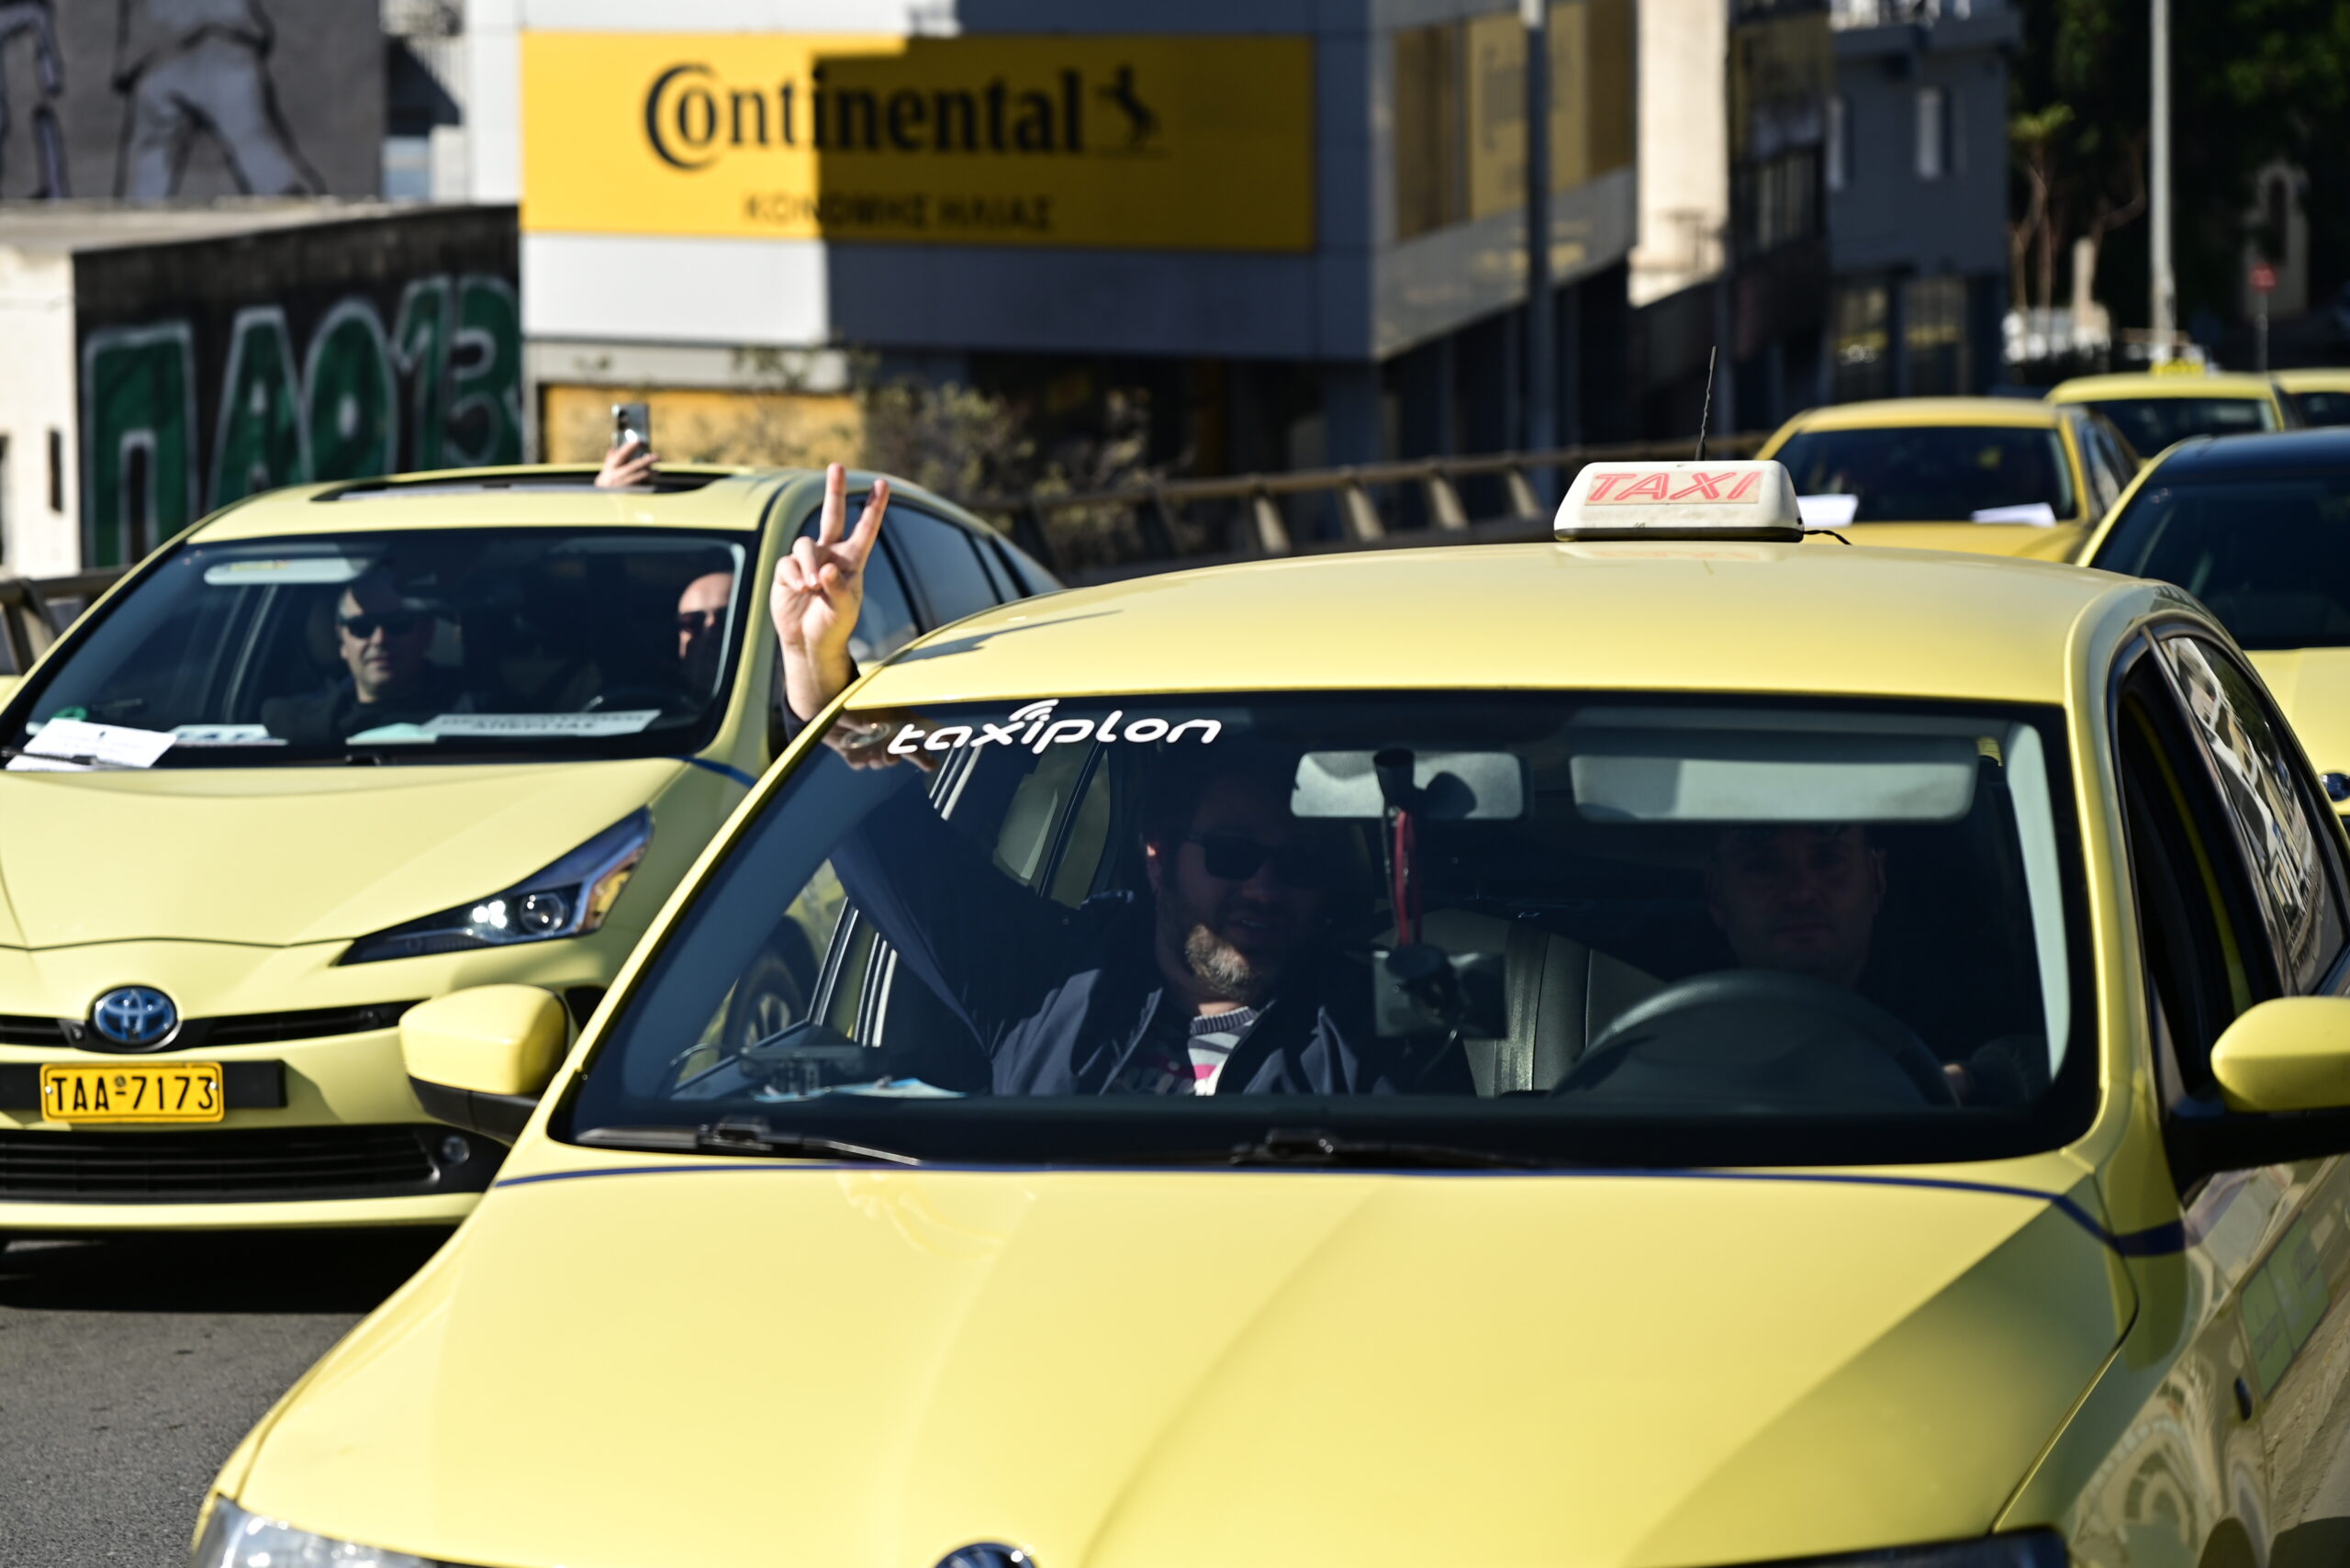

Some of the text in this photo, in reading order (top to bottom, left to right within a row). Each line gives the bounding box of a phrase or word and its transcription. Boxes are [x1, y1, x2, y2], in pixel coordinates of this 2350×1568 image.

[644, 62, 1083, 172] Continental
[1588, 471, 1762, 501] TAXI
[888, 700, 1222, 754] taxiplon
[51, 1076, 213, 1112] TAA-7173
